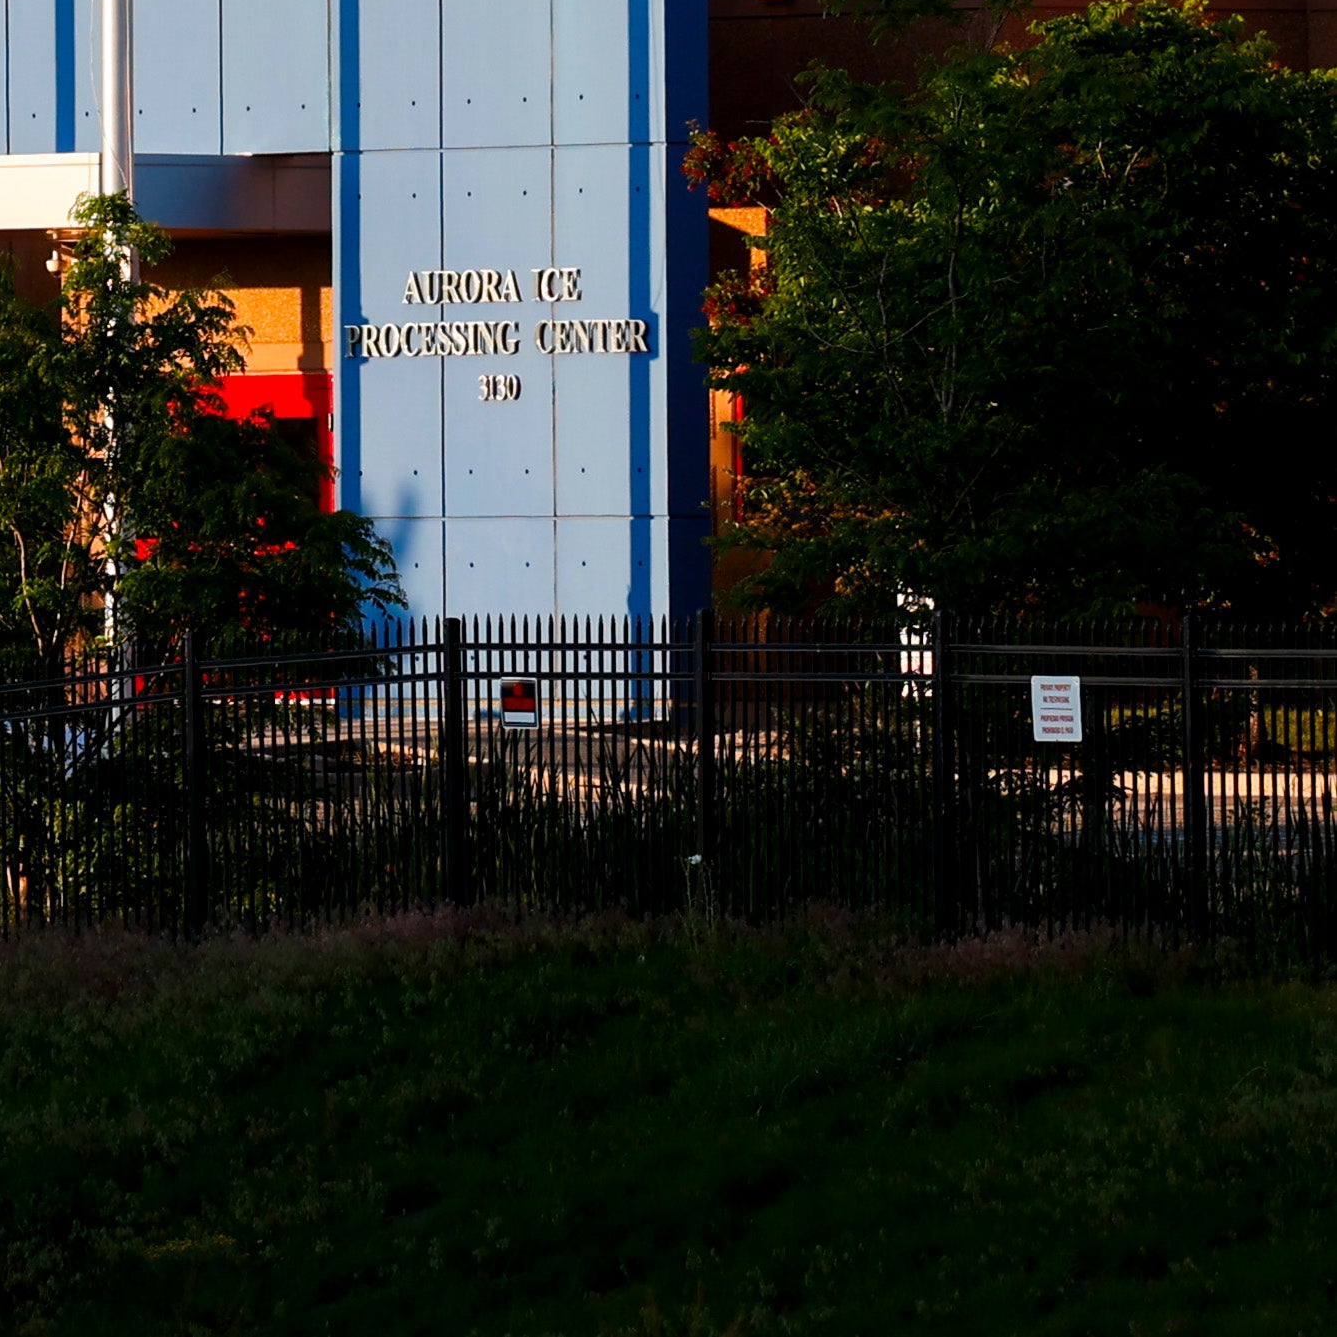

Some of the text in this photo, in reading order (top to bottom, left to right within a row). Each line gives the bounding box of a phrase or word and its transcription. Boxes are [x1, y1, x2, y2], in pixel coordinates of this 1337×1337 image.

[402, 267, 582, 304] AURORA ICE
[344, 319, 649, 357] PROCESSING CENTER
[478, 374, 521, 401] 3130
